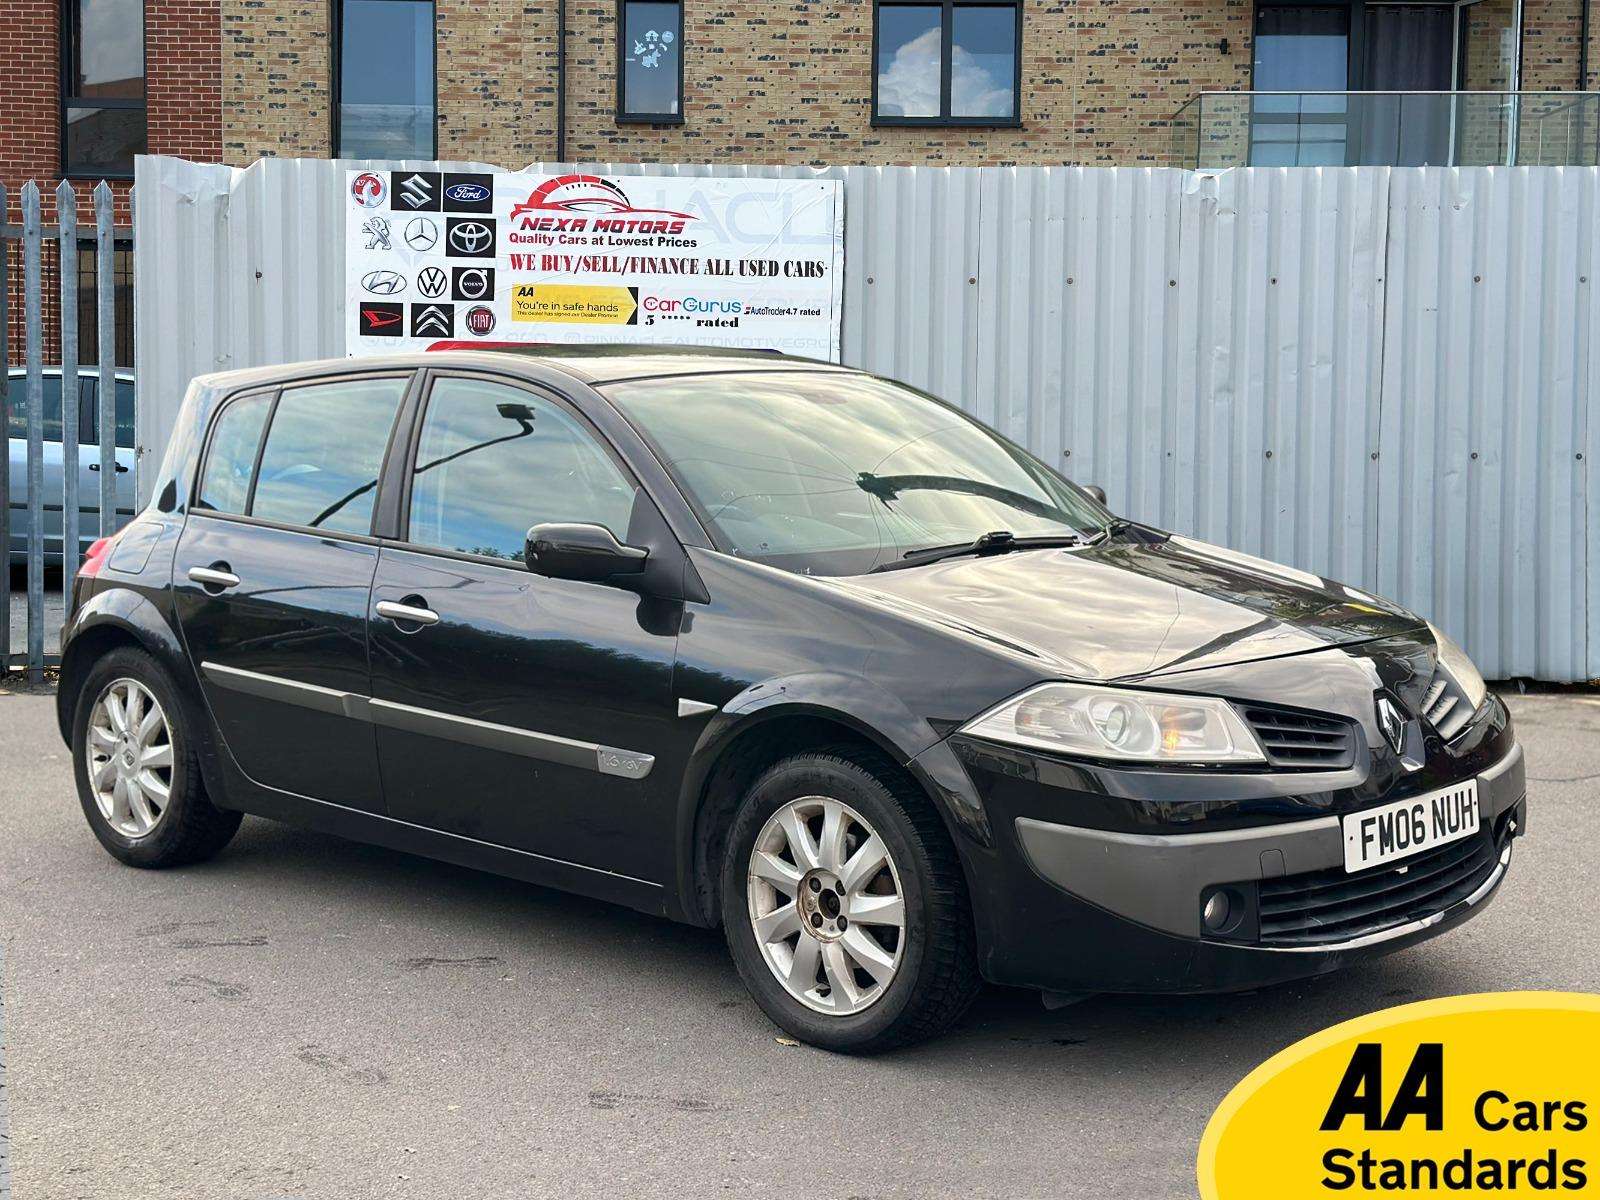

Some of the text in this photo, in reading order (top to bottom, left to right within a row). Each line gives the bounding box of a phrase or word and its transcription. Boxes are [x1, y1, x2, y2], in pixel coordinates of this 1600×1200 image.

[453, 187, 481, 199] Ford
[519, 217, 686, 235] NEXA MOTORS
[509, 233, 698, 248] Quality Cars at Lowest Prices
[510, 254, 536, 271] WE
[541, 254, 699, 276] BUY/SELL/FINANCE
[703, 259, 734, 276] ALL
[738, 260, 780, 277] USED
[517, 287, 534, 297] AA
[516, 300, 619, 312] You're in safe hands
[643, 296, 742, 314] CarGurus
[799, 308, 821, 316] rated
[473, 314, 491, 328] FIAT
[644, 315, 739, 328] 5 rated
[1361, 788, 1475, 861] FM06 NUH
